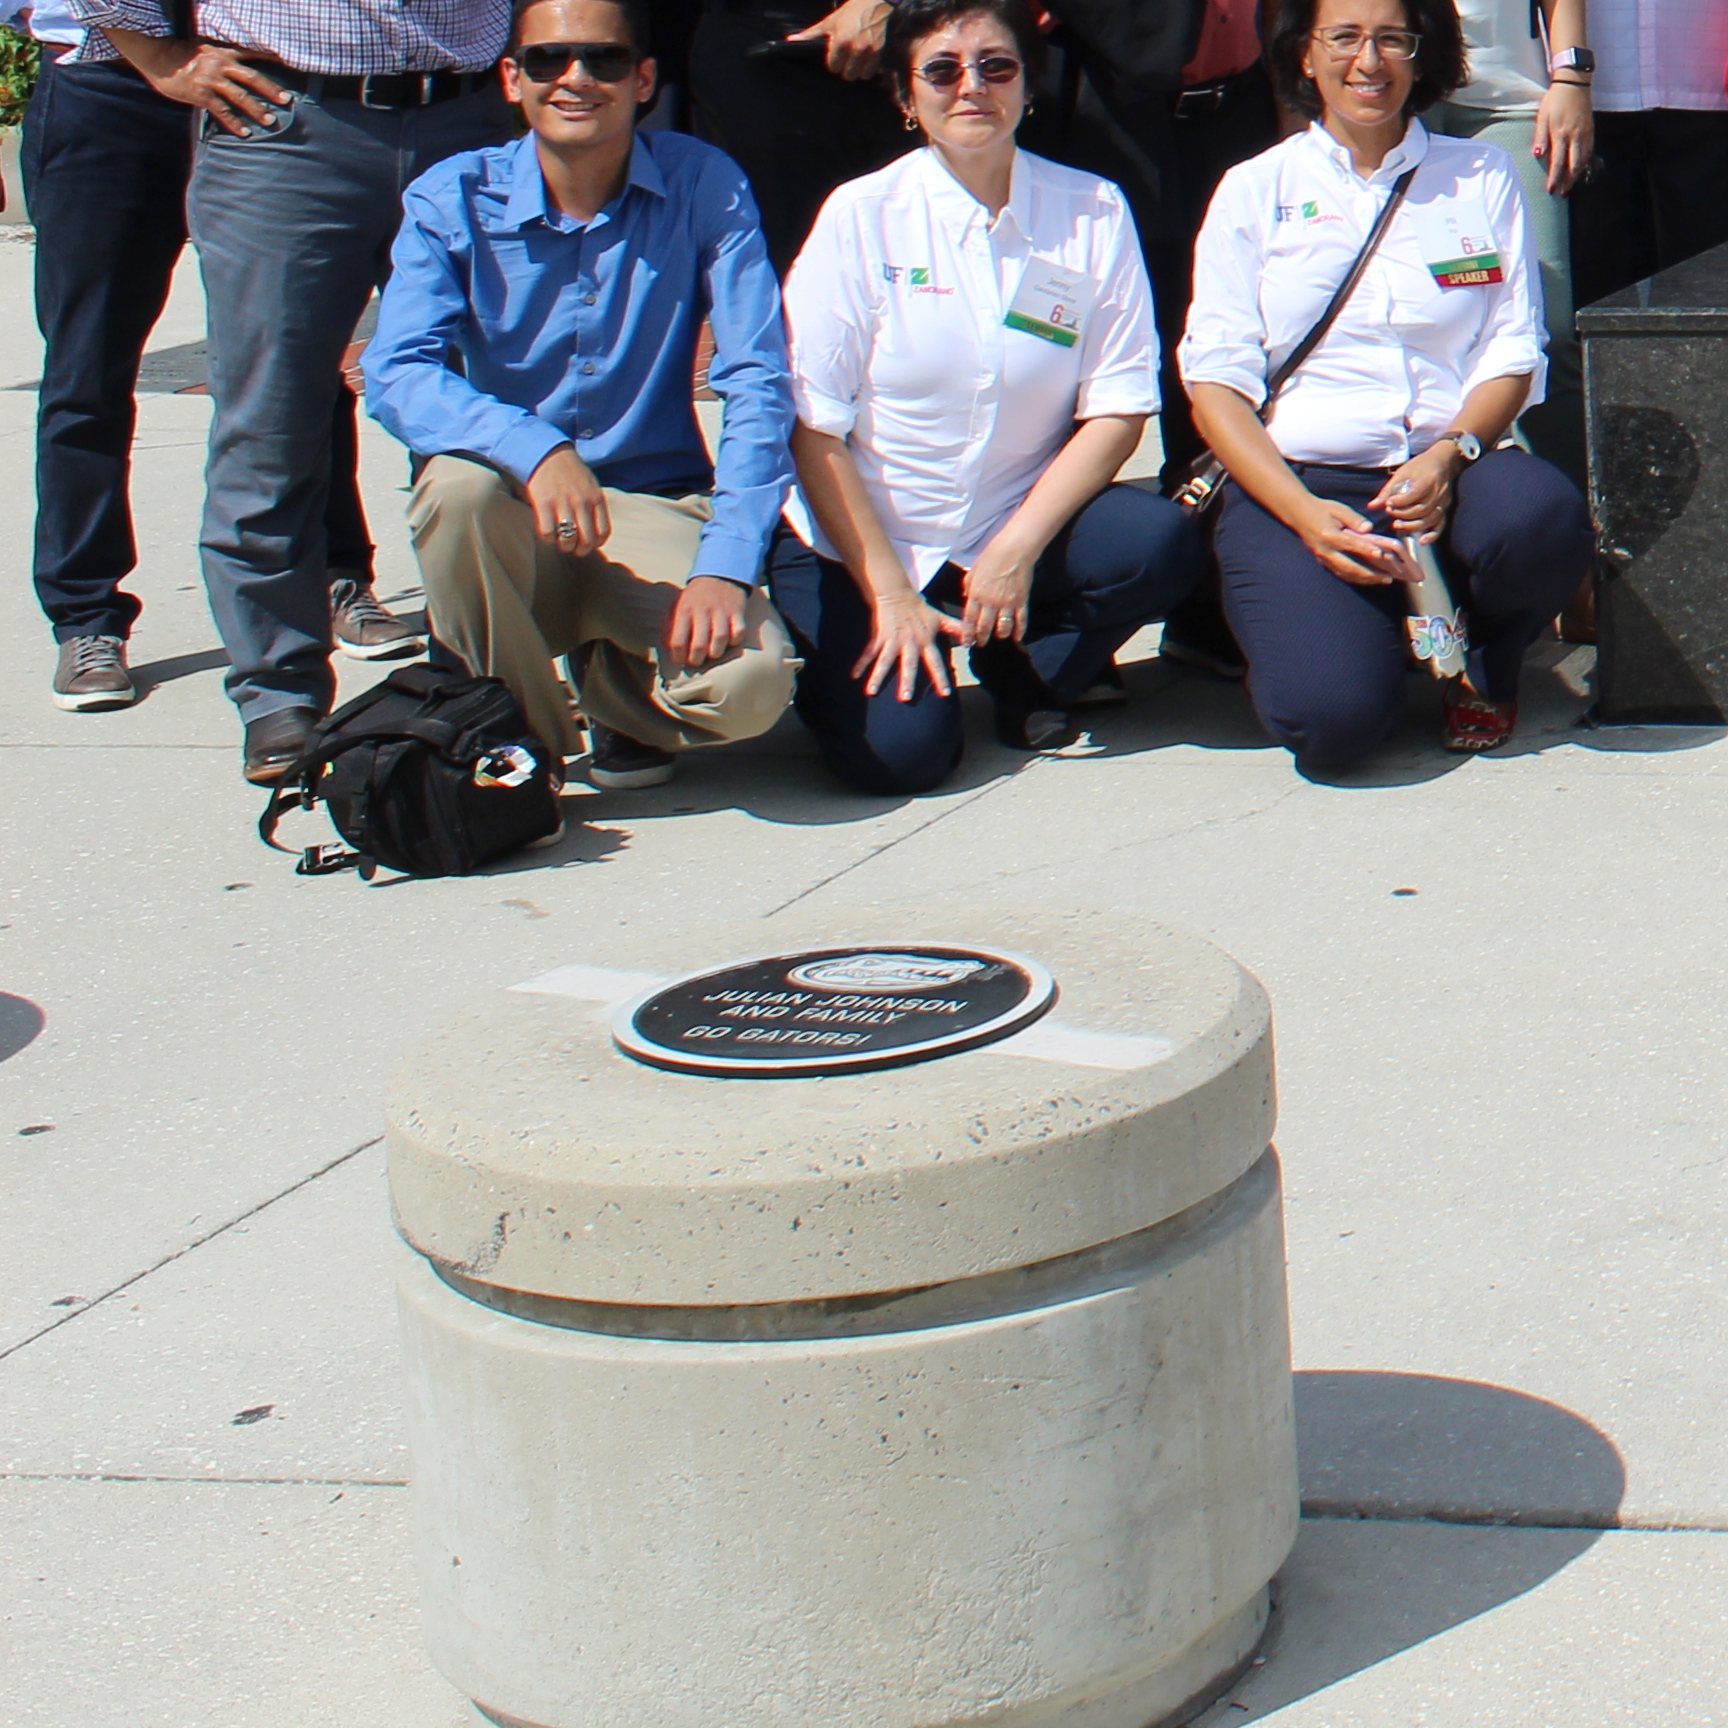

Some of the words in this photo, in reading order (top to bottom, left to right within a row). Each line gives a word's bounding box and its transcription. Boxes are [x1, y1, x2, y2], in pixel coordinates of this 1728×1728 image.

[883, 262, 904, 284] UF
[1448, 271, 1490, 284] SPEAKER
[703, 989, 816, 1006] JULIAN
[815, 993, 969, 1014] JOHNSON
[719, 1004, 791, 1020] AND
[794, 1007, 907, 1025] FAMILY
[682, 1024, 730, 1040] GO
[737, 1027, 872, 1047] GATORS!
